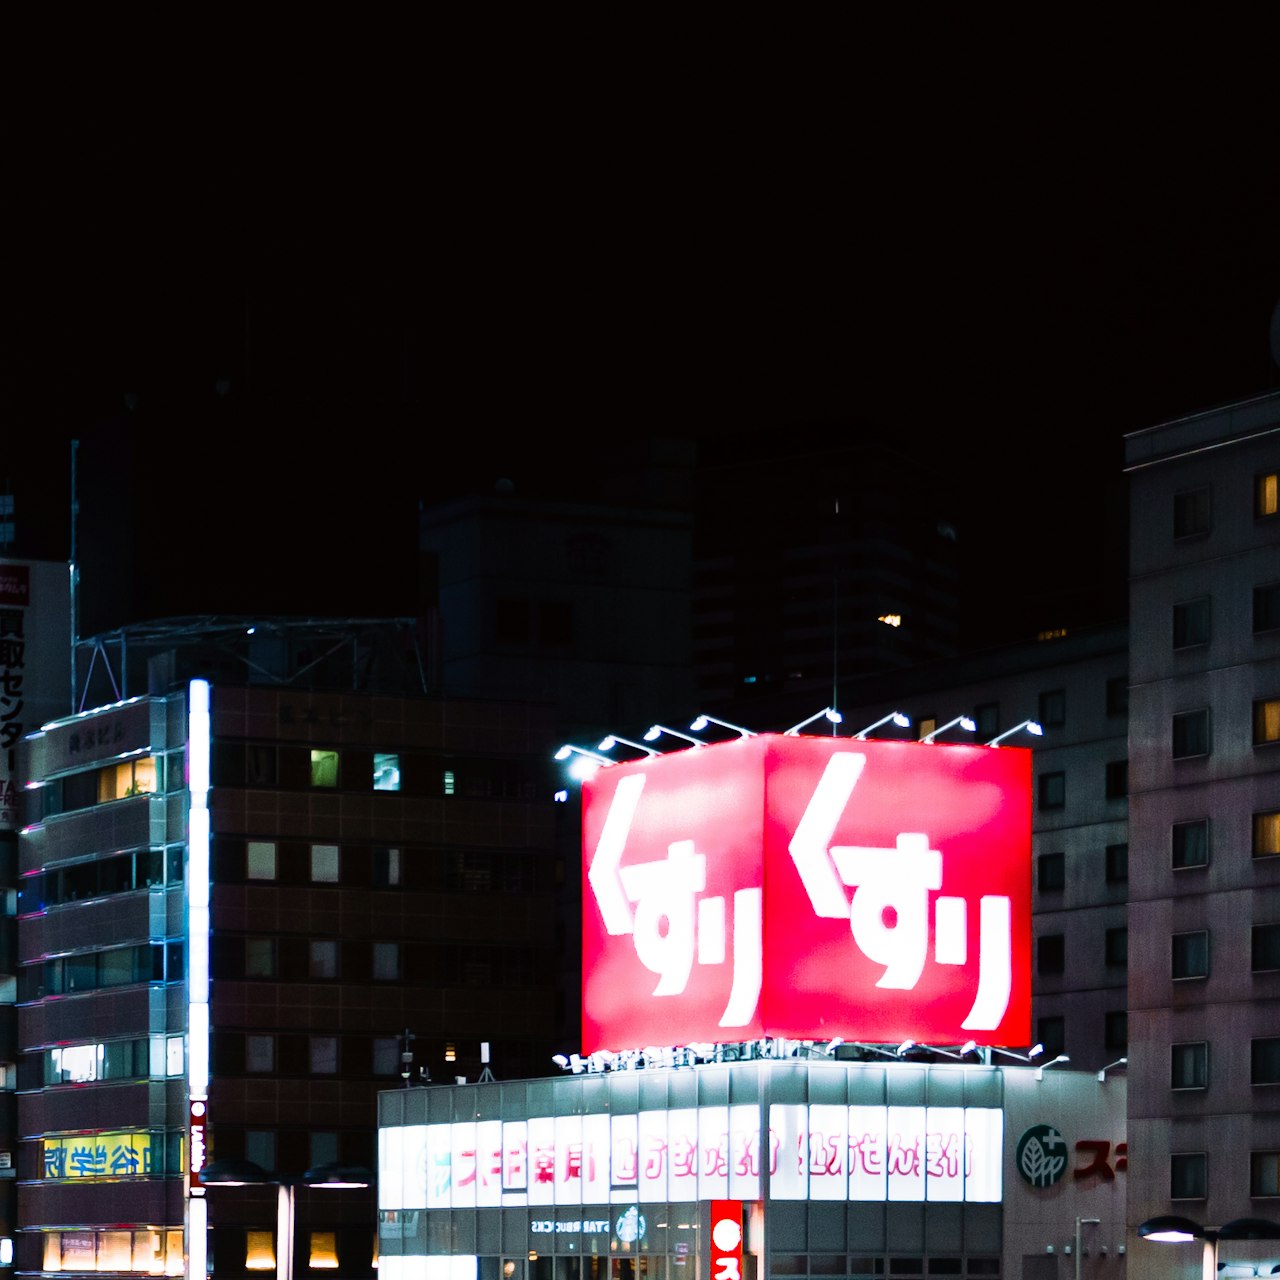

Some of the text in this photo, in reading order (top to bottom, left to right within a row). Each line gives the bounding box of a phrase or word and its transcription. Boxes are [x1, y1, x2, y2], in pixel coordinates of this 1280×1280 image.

[588, 773, 763, 1028] くすり
[788, 751, 1012, 1031] くすり
[457, 1141, 595, 1187] スギ薬局
[798, 1130, 975, 1179] 処方せん受付
